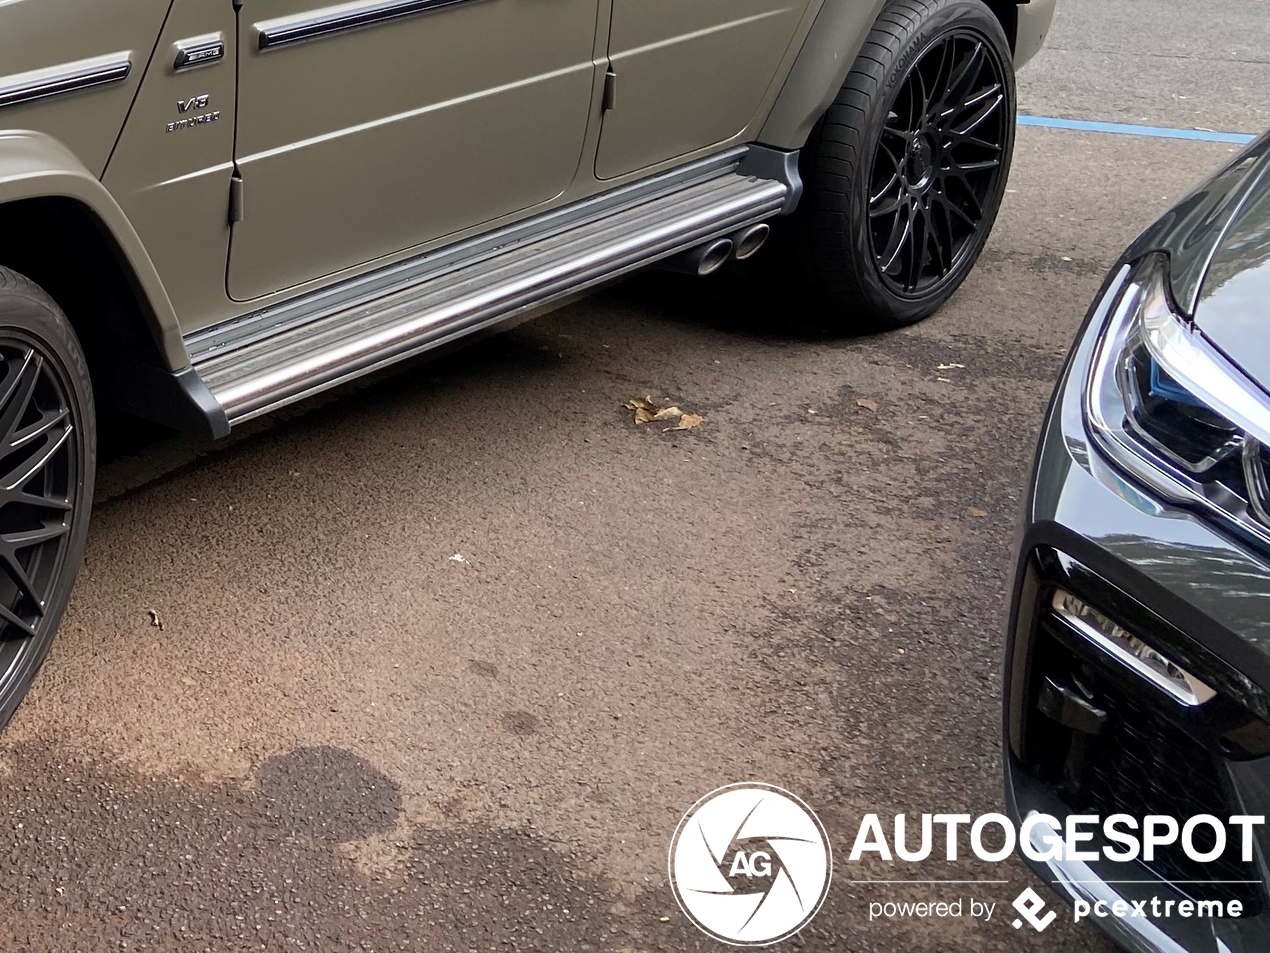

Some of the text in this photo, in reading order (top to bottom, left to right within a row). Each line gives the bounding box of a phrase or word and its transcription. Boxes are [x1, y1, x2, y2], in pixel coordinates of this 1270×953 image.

[886, 32, 926, 88] YOKOHAMA
[177, 94, 209, 113] V8
[166, 111, 220, 133] BITURBO
